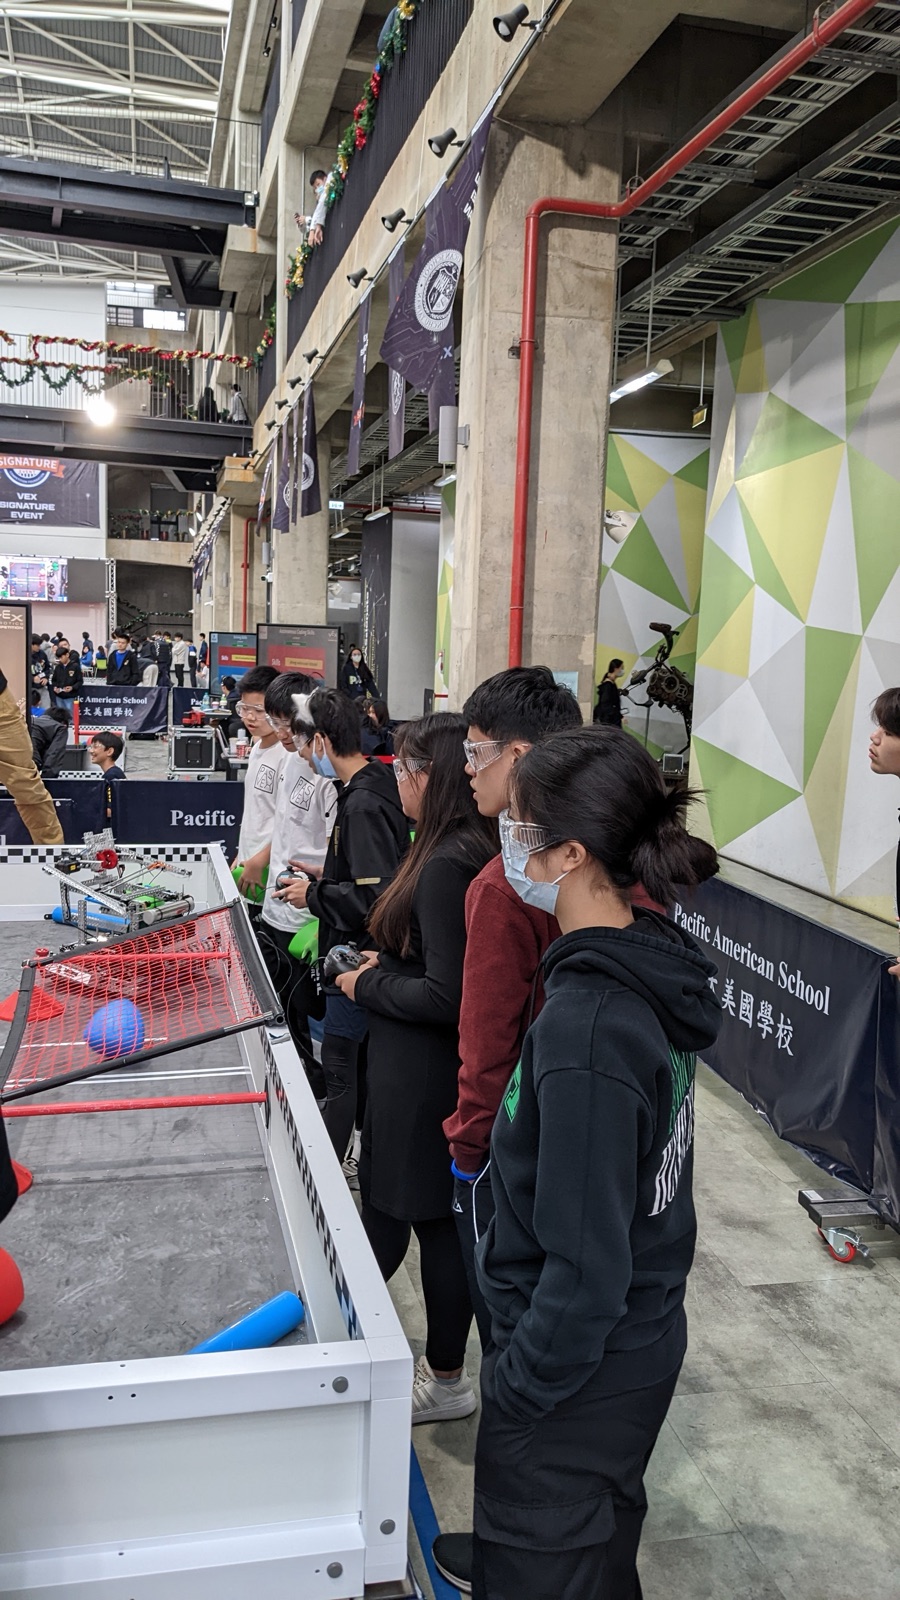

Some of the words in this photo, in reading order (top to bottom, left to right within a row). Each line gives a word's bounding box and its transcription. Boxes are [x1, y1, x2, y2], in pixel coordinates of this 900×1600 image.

[0, 456, 57, 469] SIGNATURE
[16, 492, 38, 501] VEX
[0, 501, 56, 511] SIGNATURE
[10, 511, 45, 519] EVENT
[0, 609, 23, 622] EX
[84, 695, 121, 704] American
[122, 696, 148, 704] School
[170, 809, 236, 826] Pacific
[674, 902, 711, 943] Pacific
[712, 925, 775, 983] American
[778, 960, 831, 1016] School
